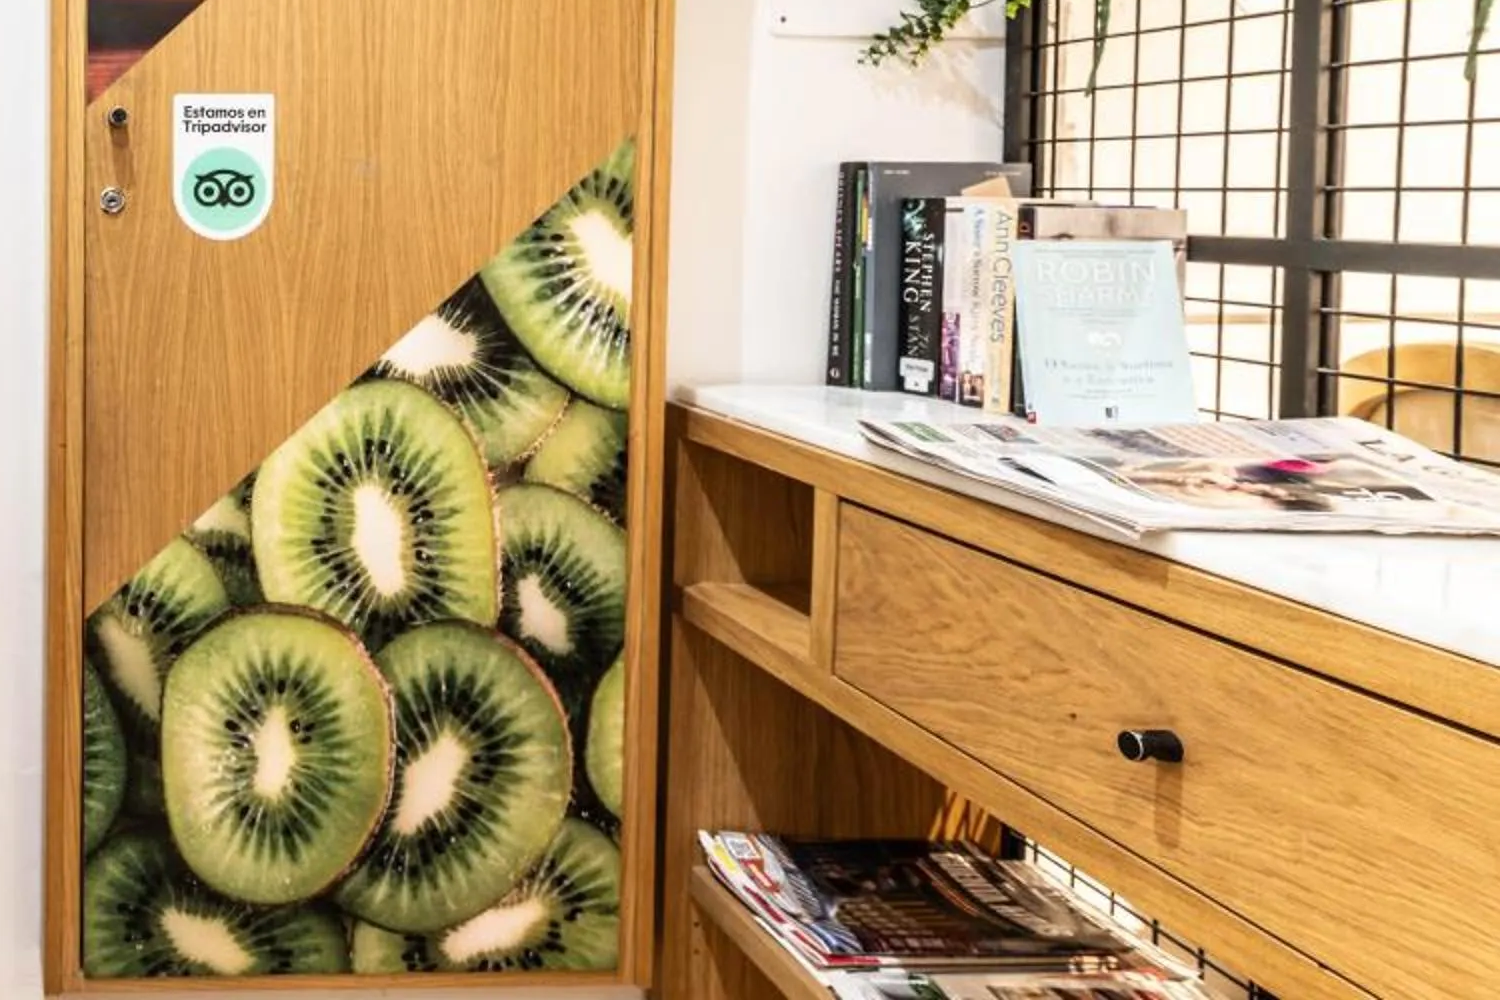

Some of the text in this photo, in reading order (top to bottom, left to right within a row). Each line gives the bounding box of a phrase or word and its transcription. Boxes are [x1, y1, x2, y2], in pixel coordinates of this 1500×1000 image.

[183, 106, 266, 119] Estamos en
[183, 120, 266, 136] Tripadvisor
[903, 241, 922, 303] KING
[919, 233, 935, 312] STEPHEN
[990, 210, 1013, 344] Ann Cleeves
[1036, 258, 1157, 283] ROBIN
[907, 313, 921, 357] STAN
